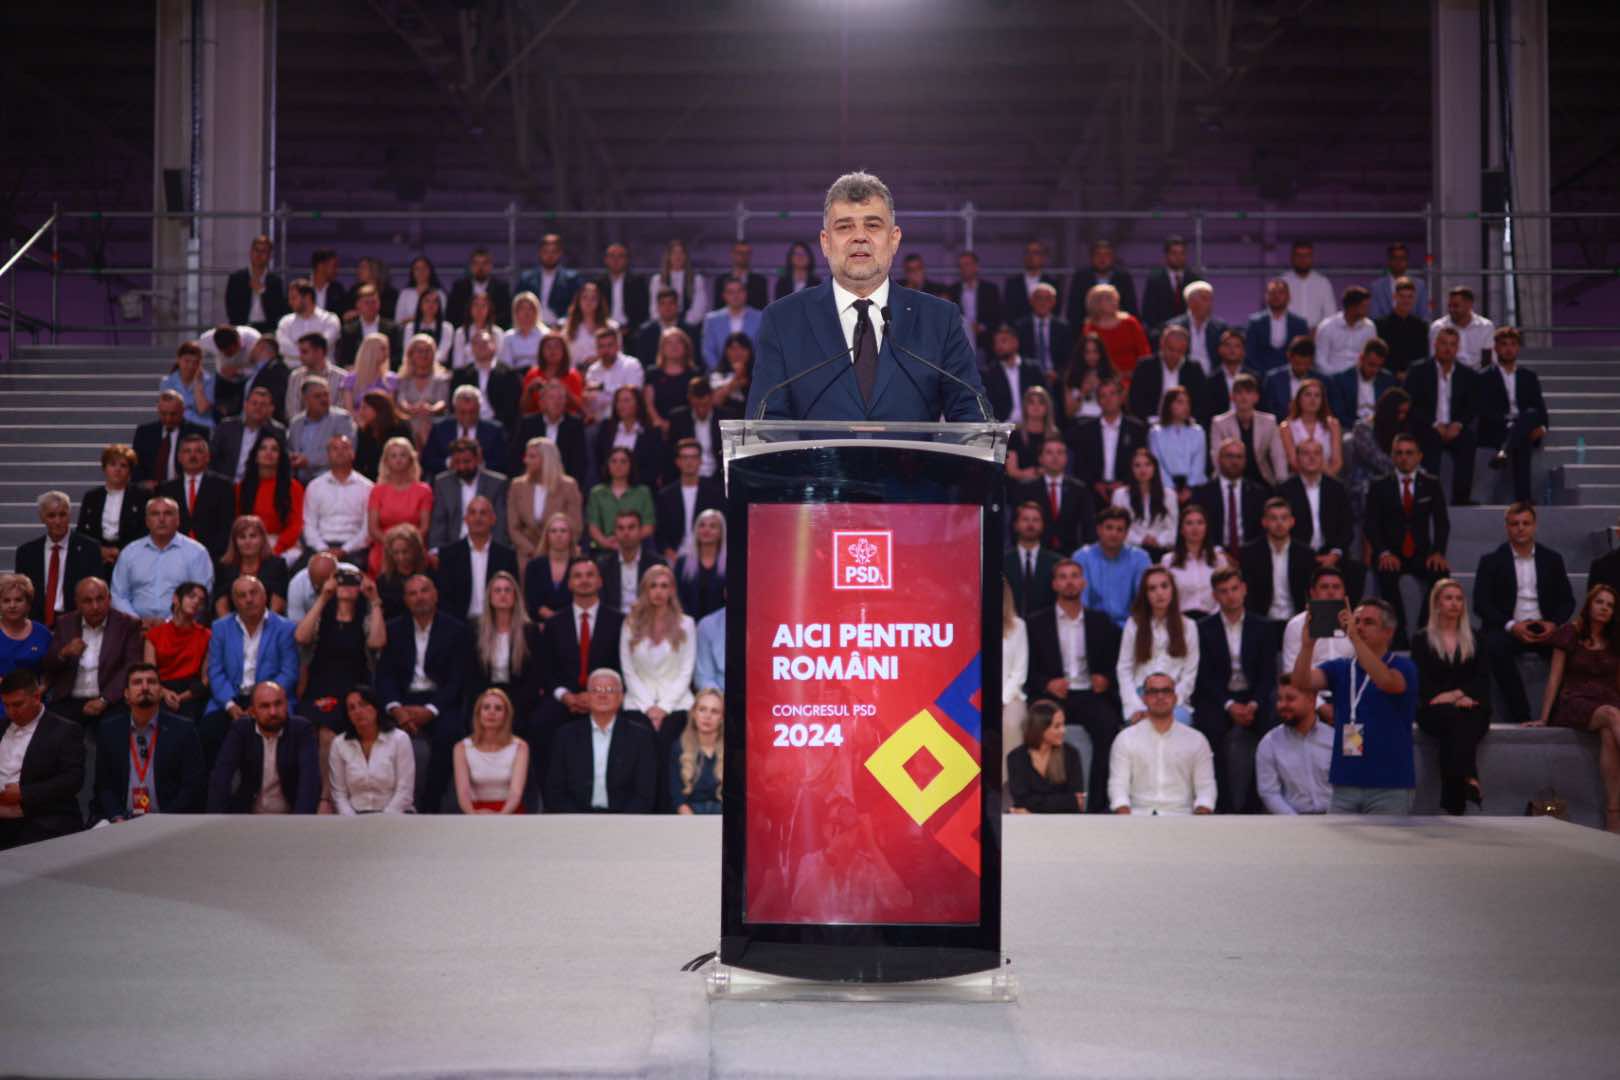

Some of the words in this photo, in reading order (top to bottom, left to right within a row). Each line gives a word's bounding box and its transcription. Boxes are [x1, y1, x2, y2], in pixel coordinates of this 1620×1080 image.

[845, 566, 880, 583] PSD
[772, 623, 831, 648] AICI
[839, 623, 954, 648] PENTRU
[772, 651, 899, 680] ROMÂNI
[772, 704, 849, 717] CONGRESUL
[853, 704, 876, 717] PSD
[773, 723, 844, 747] 2024
